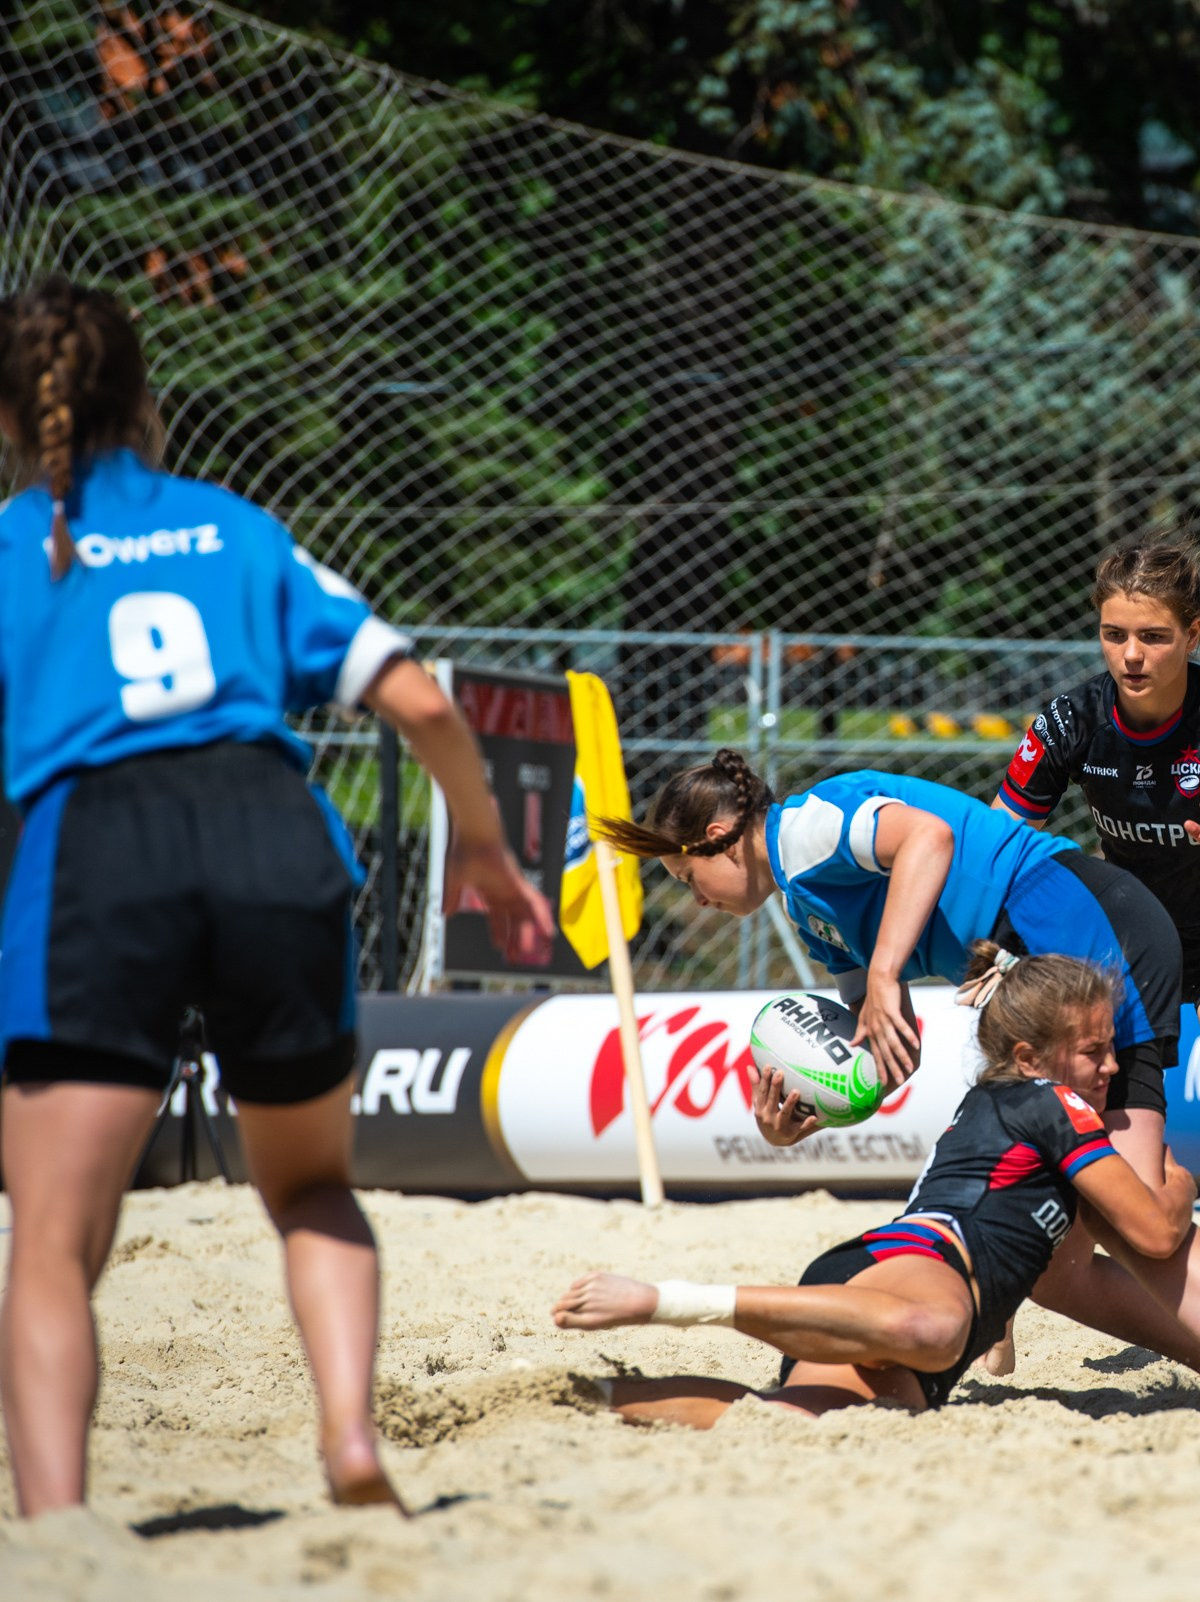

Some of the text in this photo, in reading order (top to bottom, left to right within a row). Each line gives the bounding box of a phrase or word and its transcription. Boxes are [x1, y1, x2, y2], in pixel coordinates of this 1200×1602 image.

[43, 524, 224, 568] owerz
[108, 590, 216, 723] 9
[772, 997, 853, 1066] RHINO
[780, 1015, 818, 1049] RAPIDE XV
